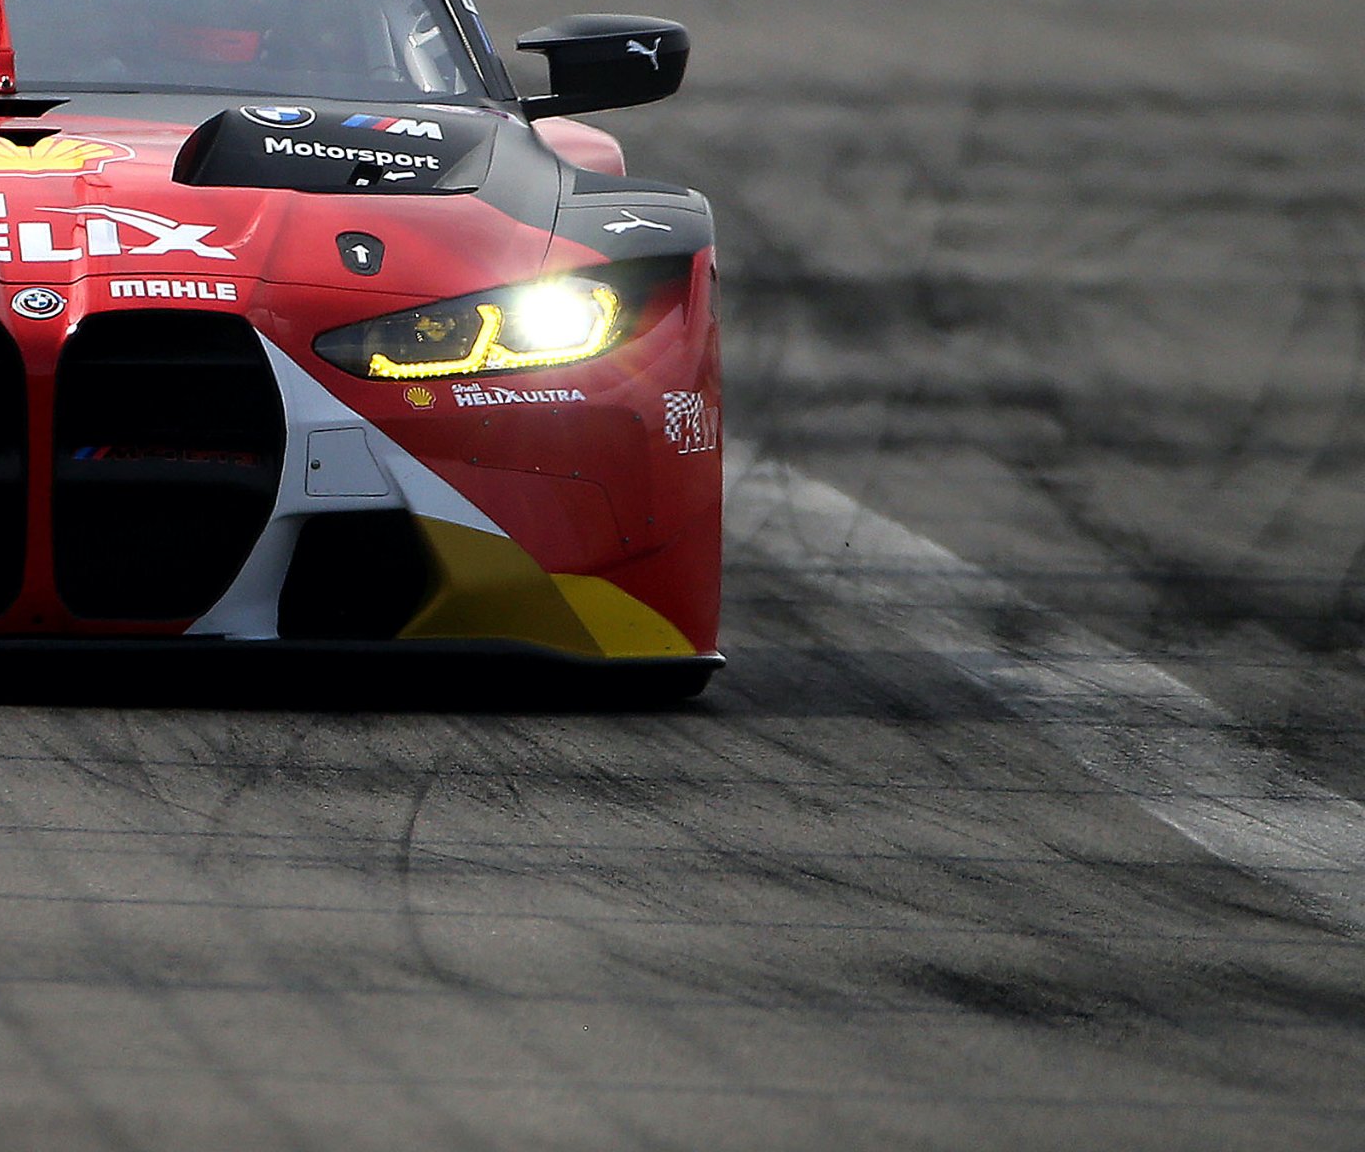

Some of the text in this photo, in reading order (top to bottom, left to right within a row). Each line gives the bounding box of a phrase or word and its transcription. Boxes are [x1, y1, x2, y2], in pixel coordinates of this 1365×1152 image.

[264, 136, 440, 170] Motorsport
[110, 280, 238, 301] MAHLE
[451, 383, 481, 393] Shell
[524, 389, 587, 403] ULTRA
